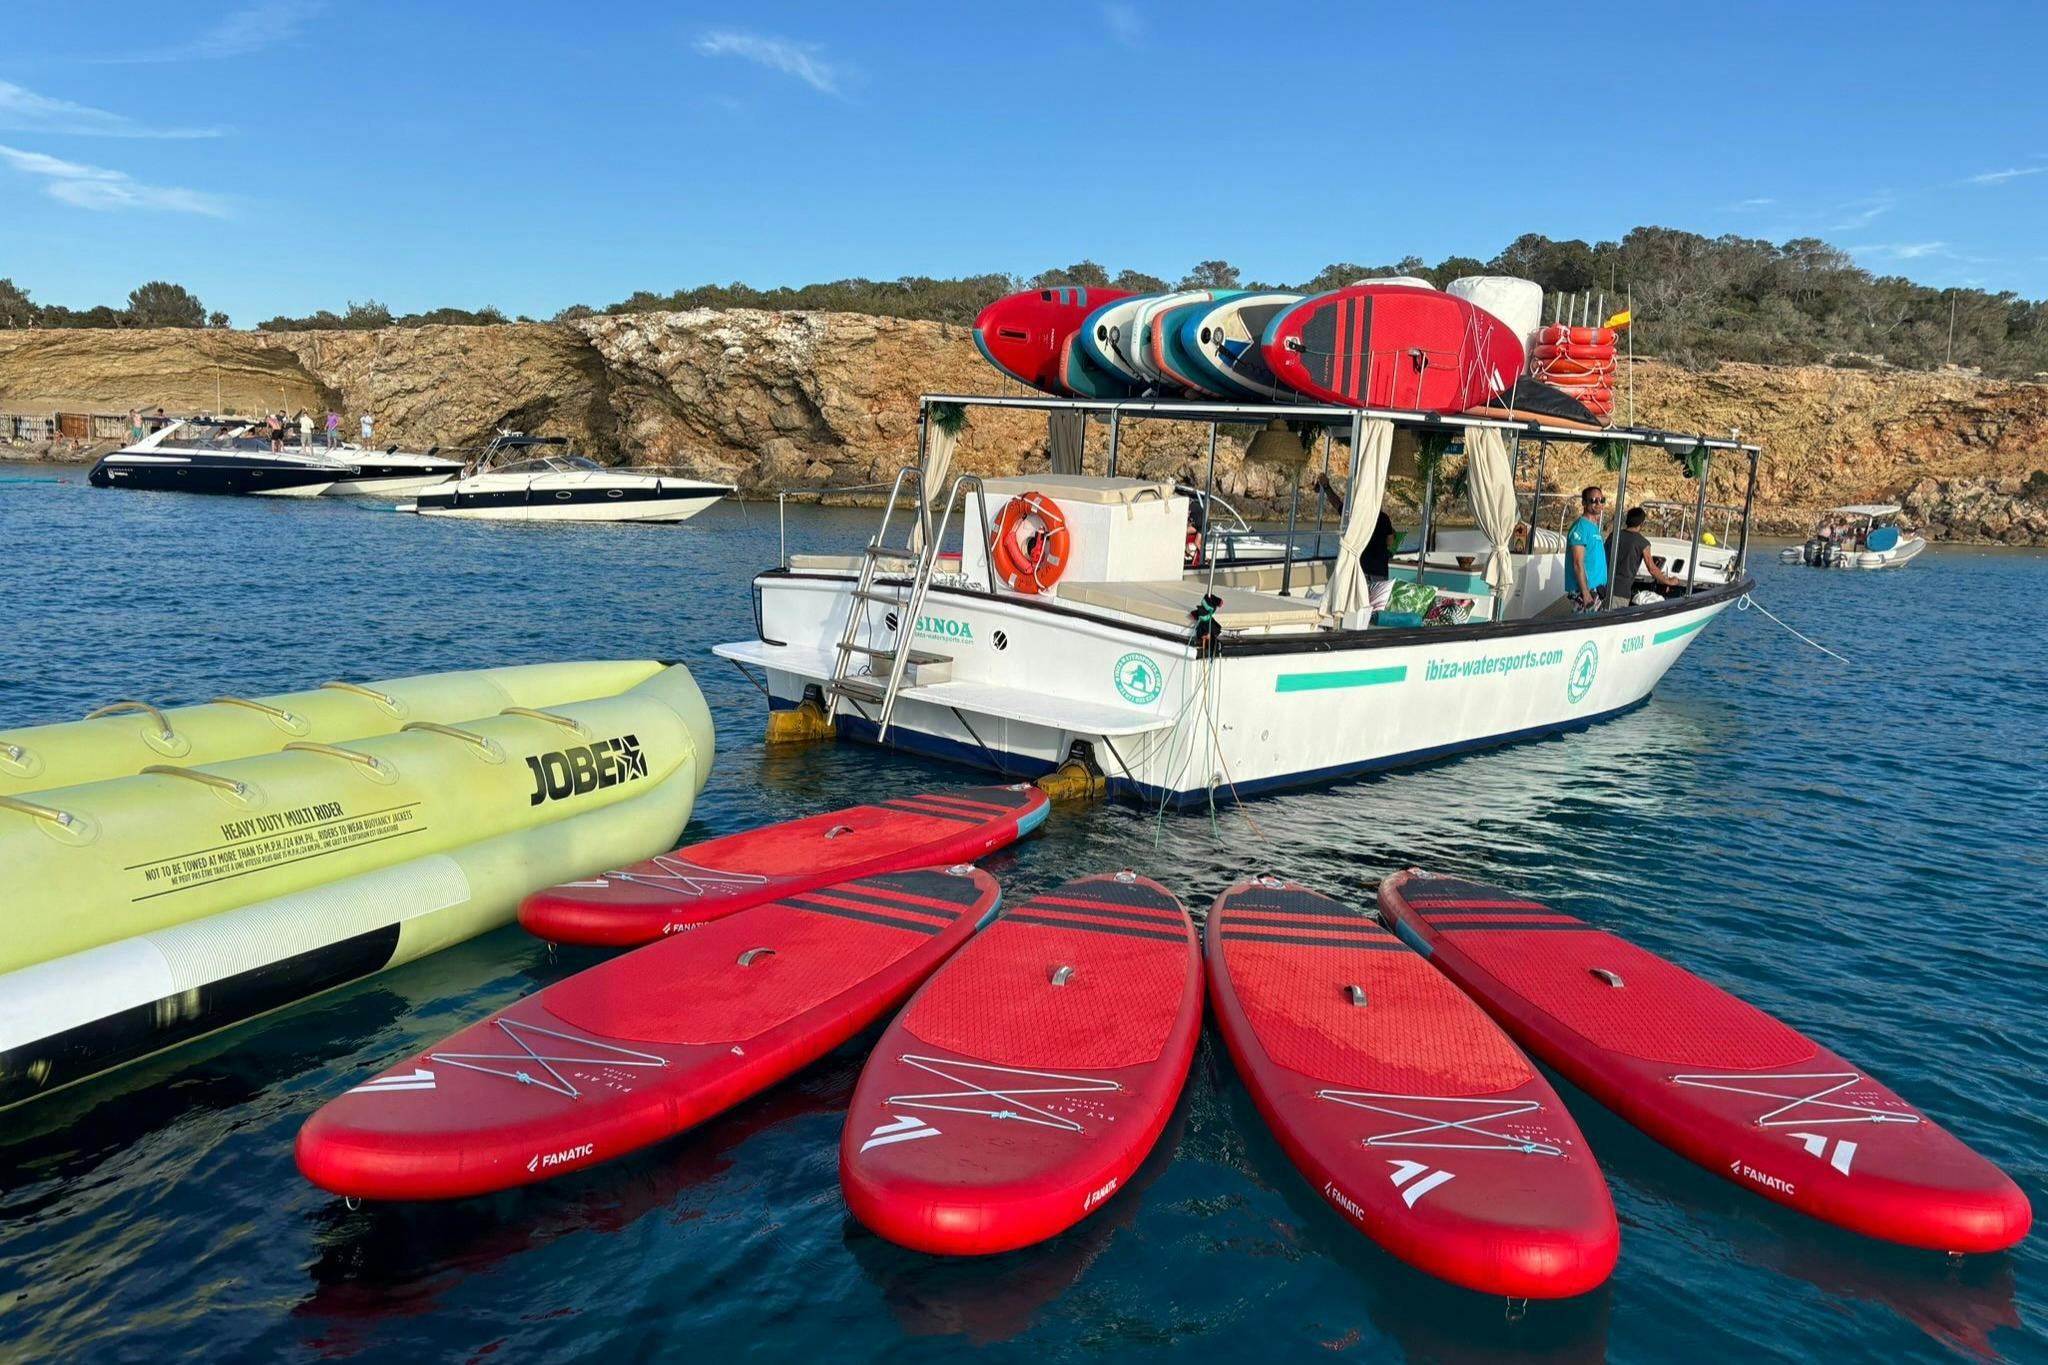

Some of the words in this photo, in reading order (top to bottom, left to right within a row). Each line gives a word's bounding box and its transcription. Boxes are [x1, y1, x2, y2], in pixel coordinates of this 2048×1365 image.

[916, 616, 973, 638] SINOA
[1621, 634, 1645, 654] SINOA
[1425, 649, 1563, 681] ibiza-watersports.com
[525, 738, 619, 806] JOBE
[221, 819, 257, 841] HEAVY
[257, 813, 285, 832] DUTY
[284, 806, 315, 826] MULTI
[313, 801, 344, 821] RIDER
[145, 867, 161, 881] NOT
[161, 866, 172, 877] TO
[172, 863, 182, 875] BE
[182, 857, 208, 872] TOWED
[208, 855, 217, 867] AT
[217, 850, 238, 864] MORE
[237, 846, 256, 859] THAN
[256, 844, 264, 855] 15
[318, 827, 339, 840] RIDERS
[338, 824, 347, 836] TO
[346, 821, 364, 833] WEAR
[363, 815, 392, 830] BUOYANCY
[391, 810, 413, 823] JACKETS
[542, 1143, 593, 1167] FANATIC
[1091, 1177, 1118, 1205] FANATIC
[1744, 1165, 1795, 1195] FANATIC
[1332, 1187, 1365, 1221] FANATIC
